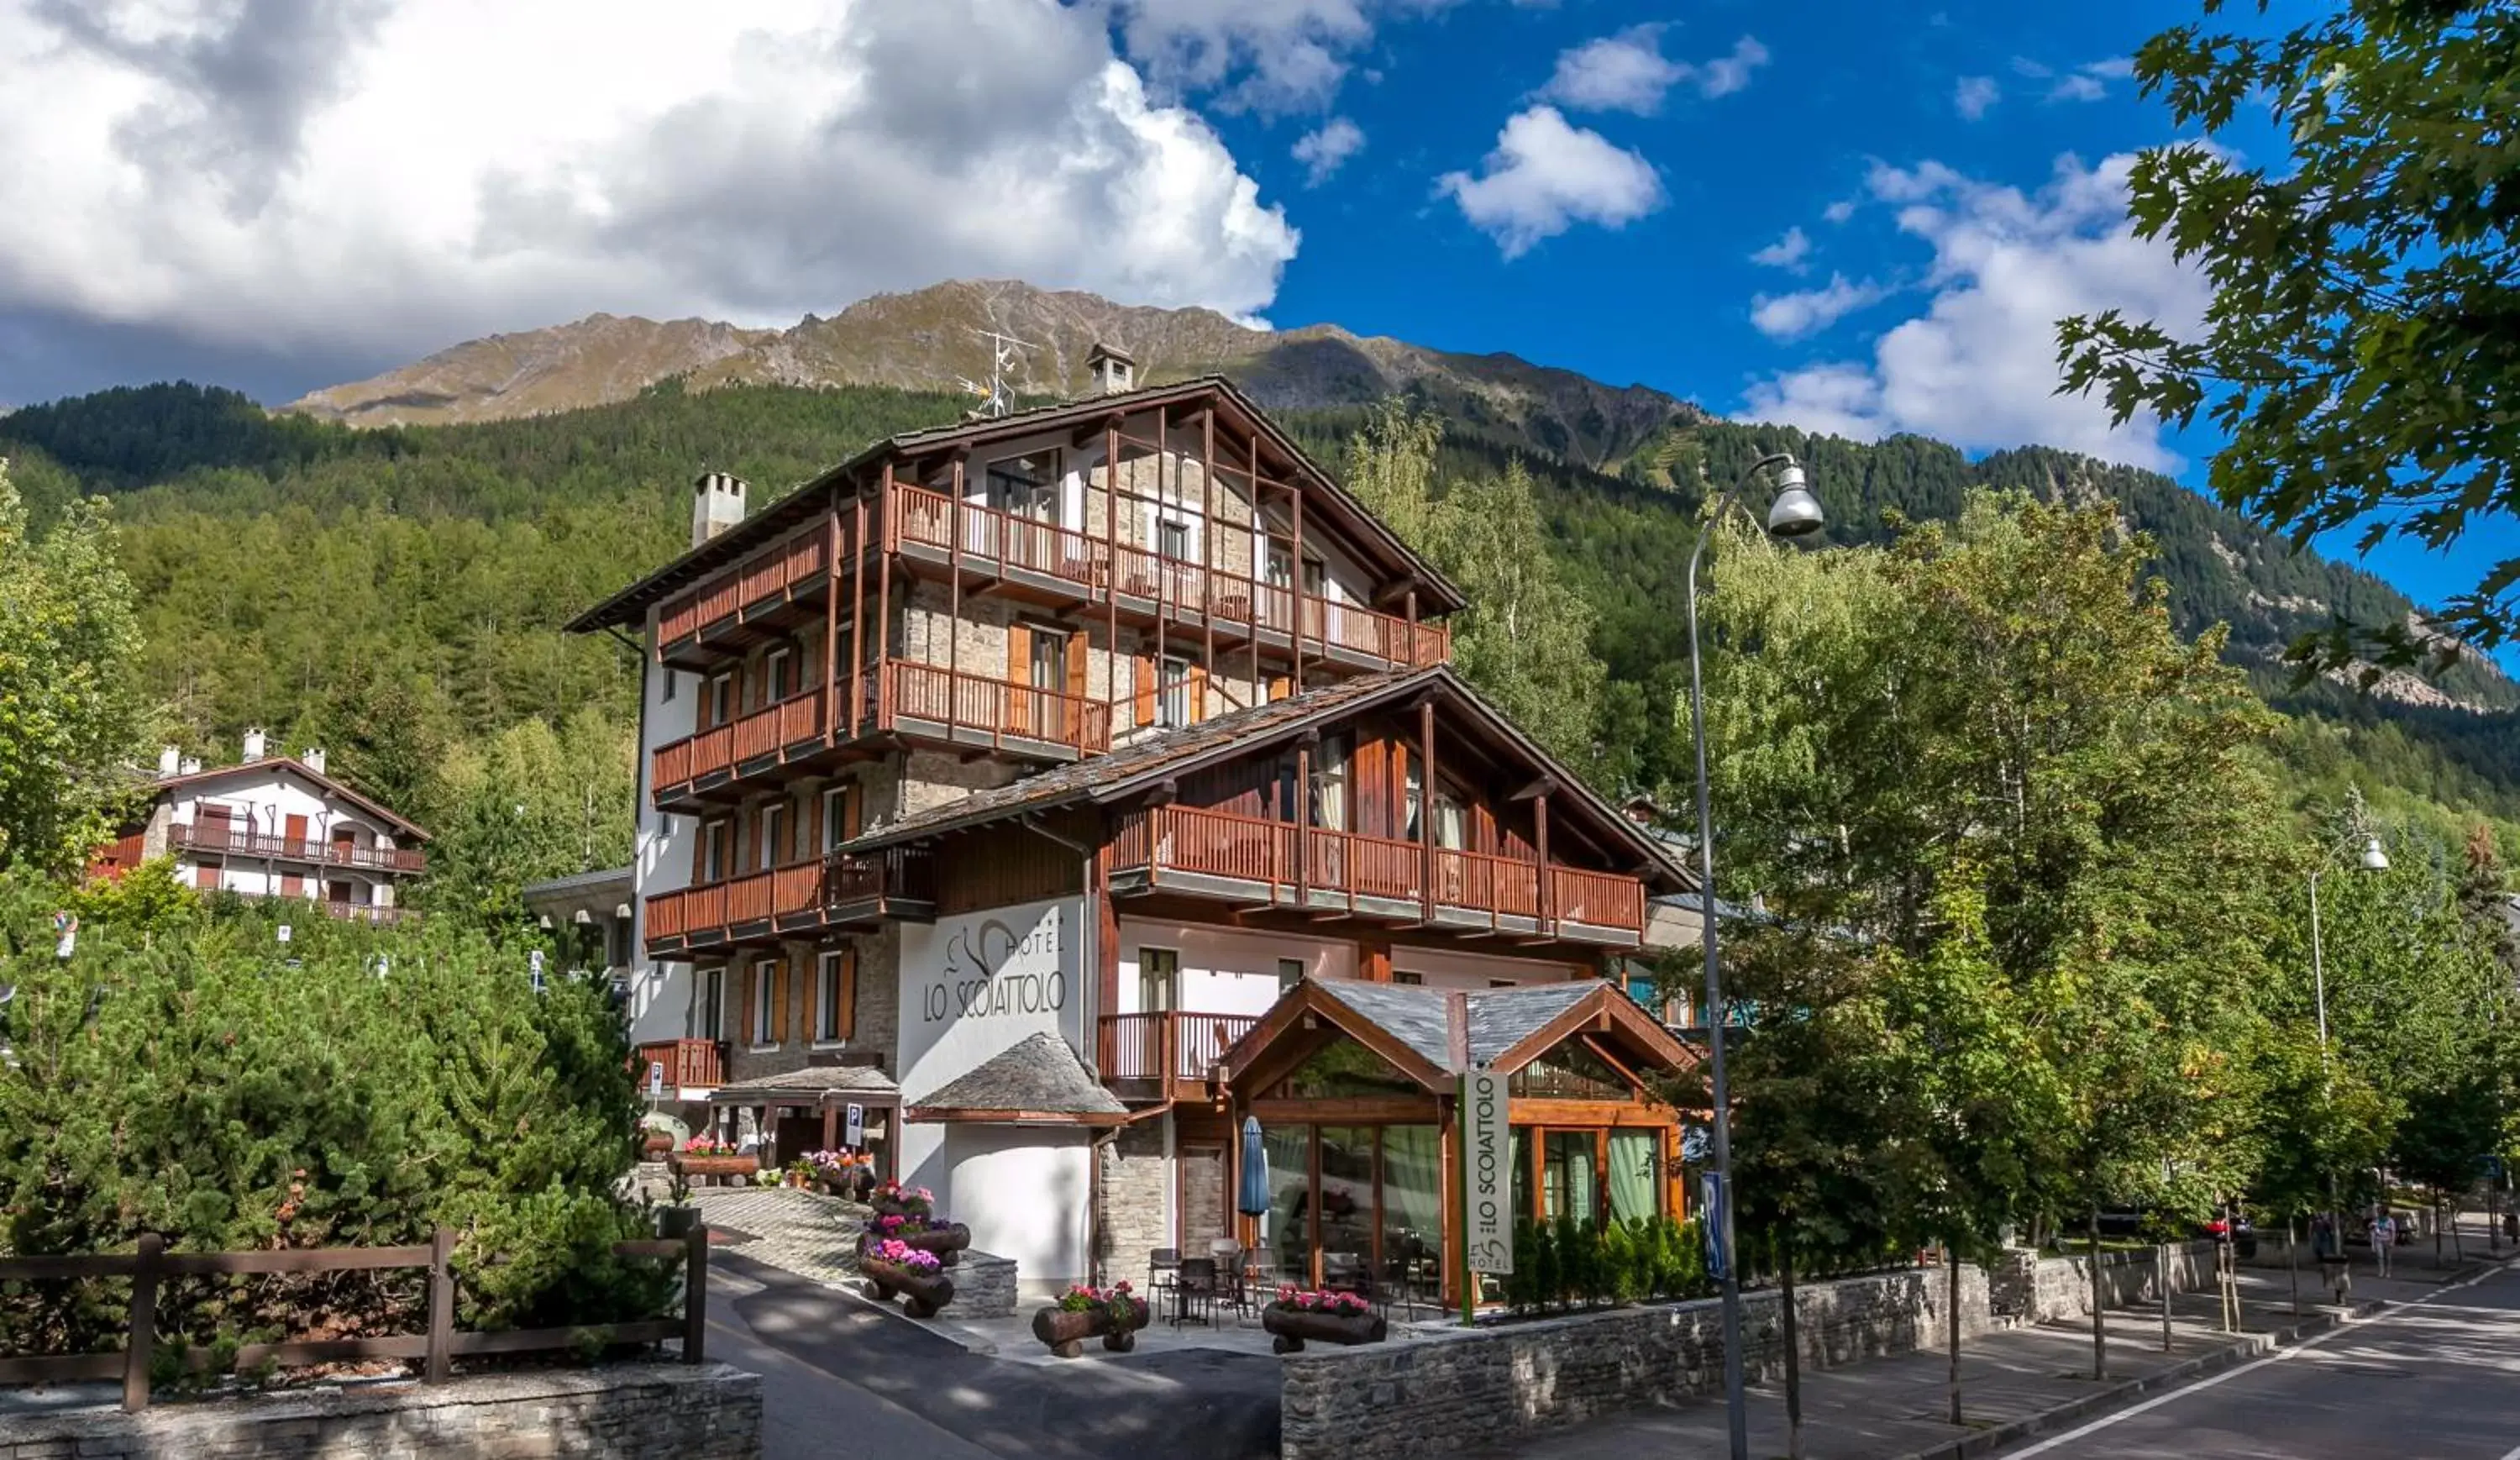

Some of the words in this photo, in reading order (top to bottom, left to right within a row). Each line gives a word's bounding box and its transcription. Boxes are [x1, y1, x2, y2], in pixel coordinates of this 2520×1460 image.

[1005, 932, 1064, 956] HOTEL
[924, 983, 947, 1022] LO
[956, 970, 1066, 1019] SCOIATTOLO
[851, 1108, 858, 1125] P
[1477, 1077, 1495, 1195] SCOIATTOLO
[1479, 1201, 1497, 1226] LO
